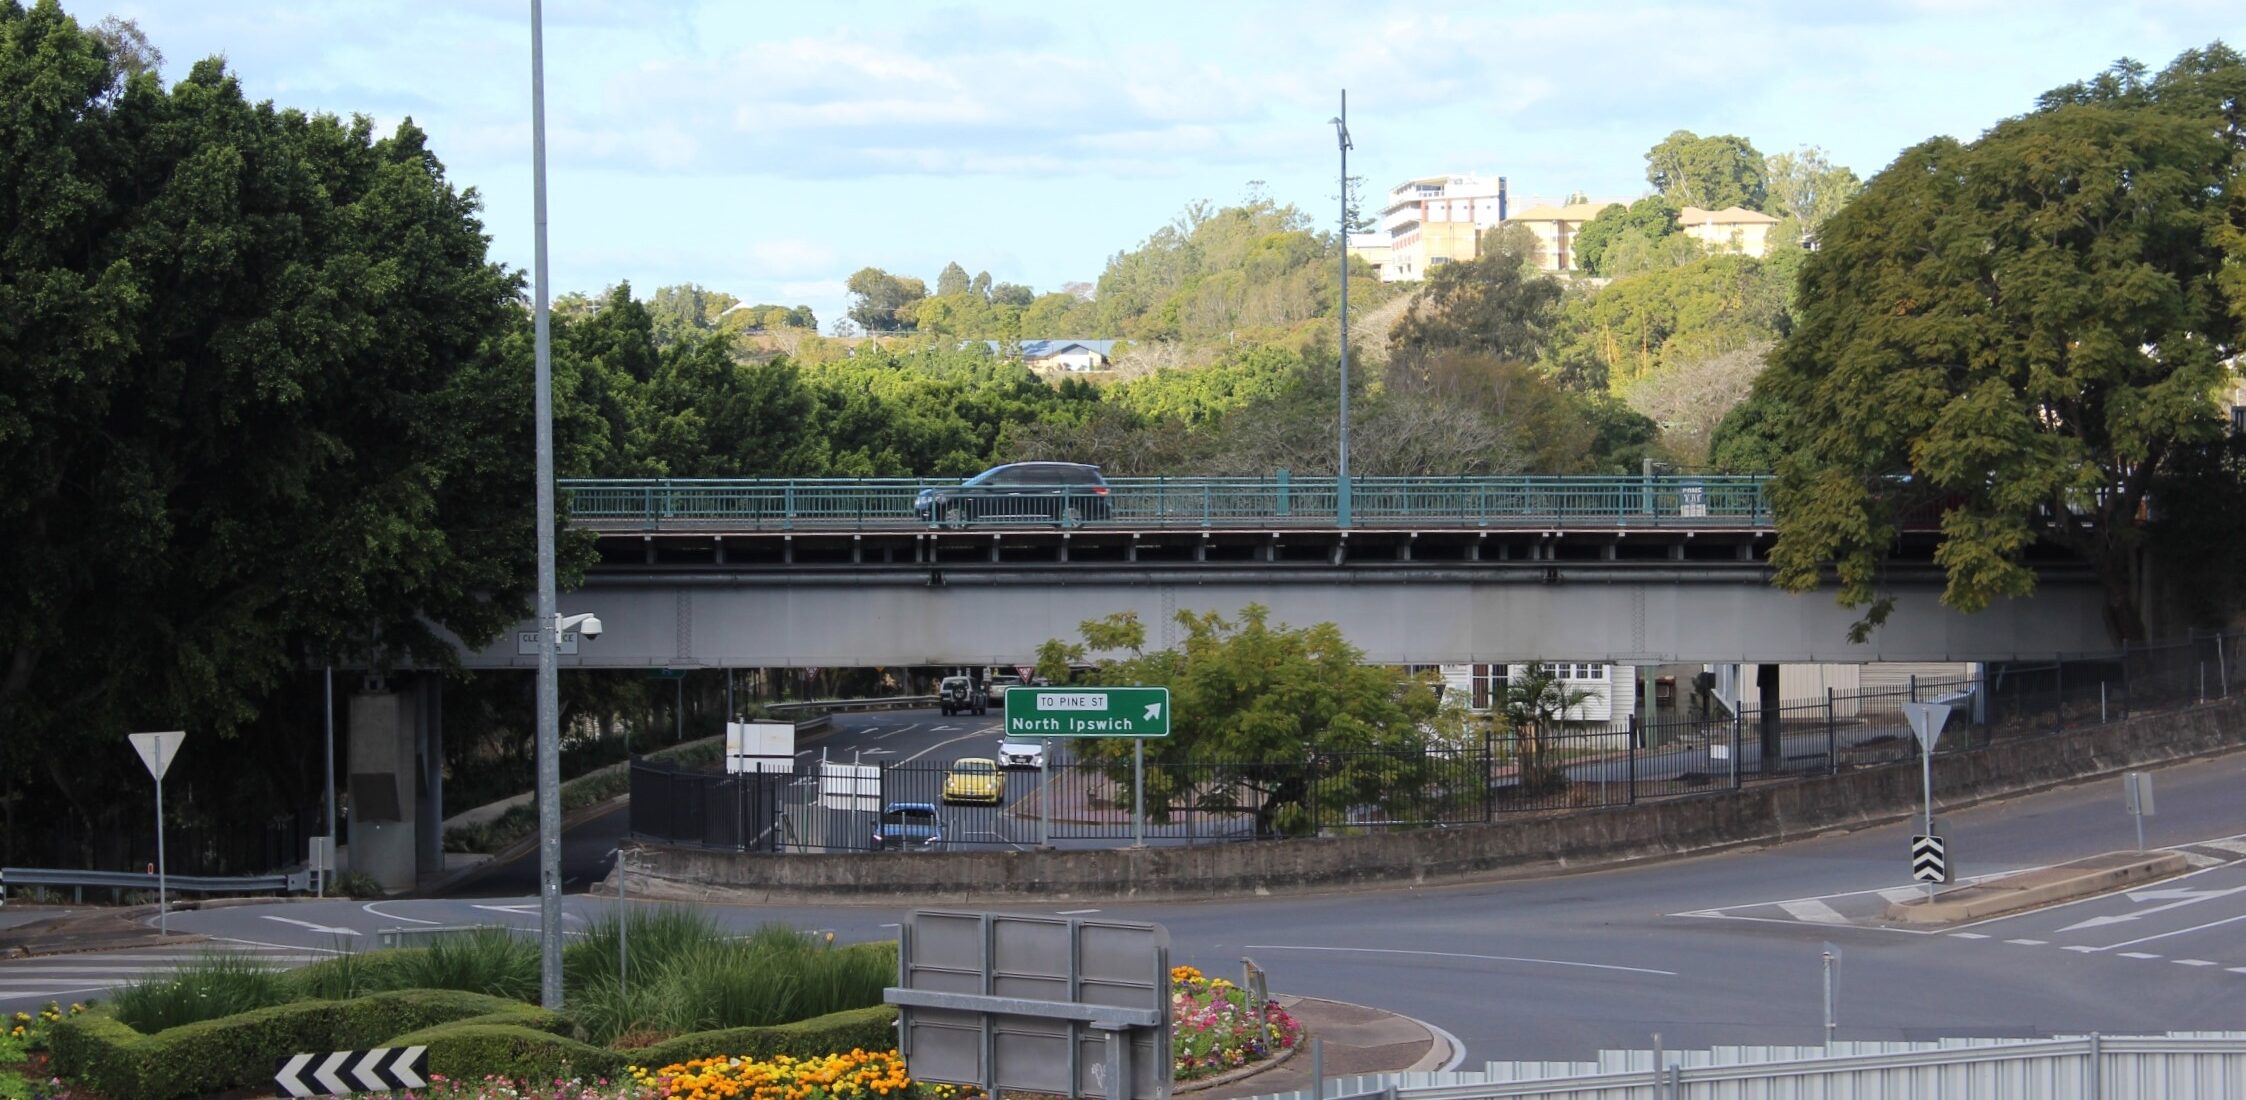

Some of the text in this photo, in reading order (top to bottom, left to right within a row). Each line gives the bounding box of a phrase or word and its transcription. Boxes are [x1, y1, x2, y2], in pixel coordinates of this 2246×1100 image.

[1041, 697, 1104, 706] TO PINE ST
[1012, 717, 1133, 732] North Ipswich
